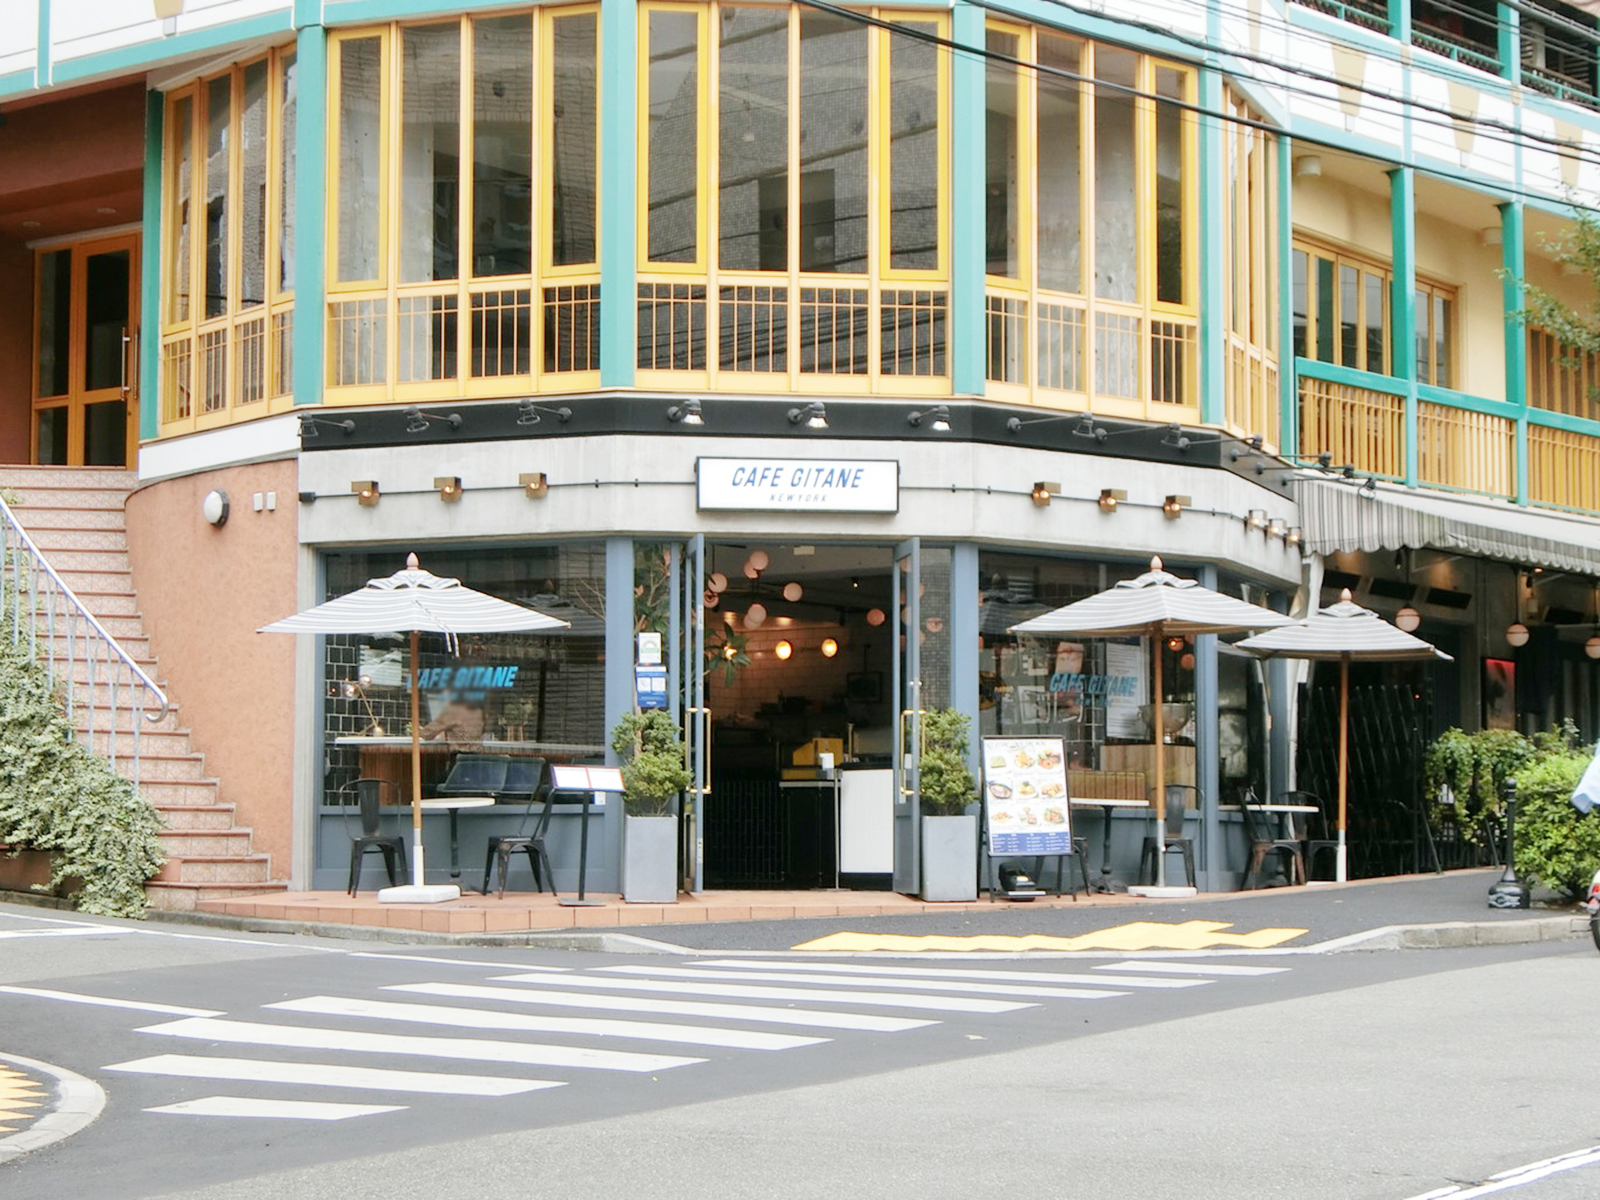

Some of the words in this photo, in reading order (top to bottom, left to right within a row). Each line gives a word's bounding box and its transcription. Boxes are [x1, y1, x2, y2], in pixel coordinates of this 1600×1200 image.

[732, 467, 783, 487] CAFE
[791, 468, 864, 488] GITANE
[1050, 673, 1085, 693] CAFE
[1088, 675, 1137, 696] GITANE
